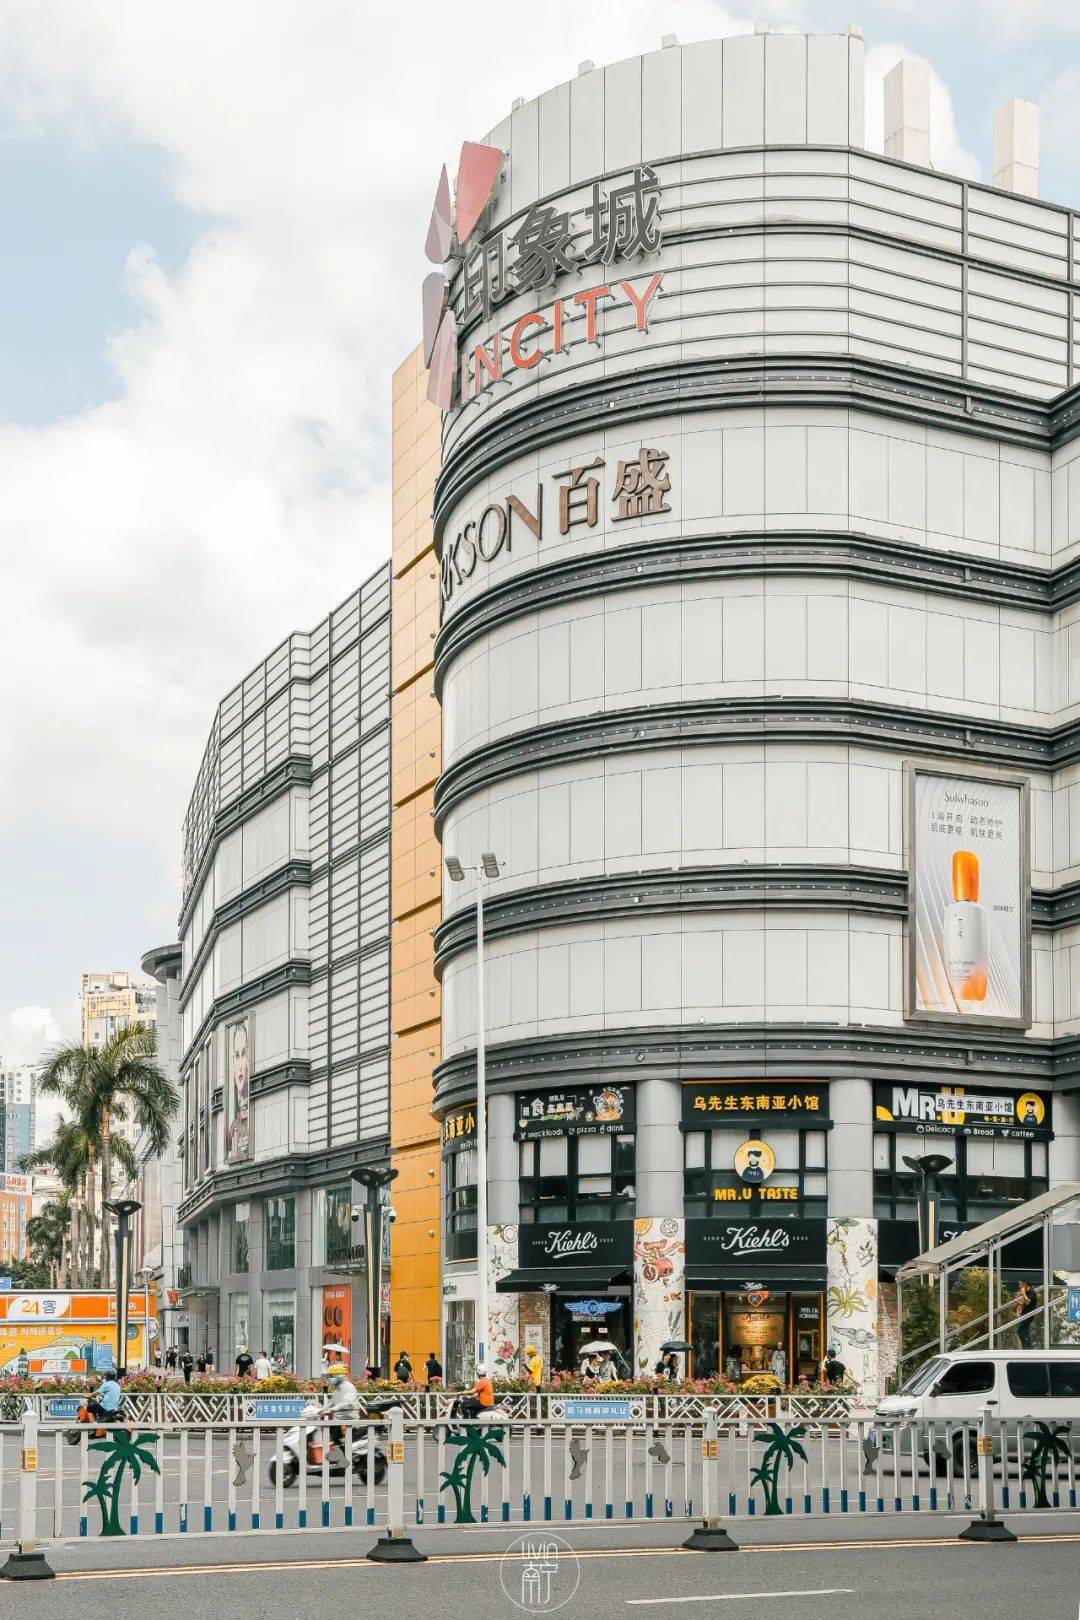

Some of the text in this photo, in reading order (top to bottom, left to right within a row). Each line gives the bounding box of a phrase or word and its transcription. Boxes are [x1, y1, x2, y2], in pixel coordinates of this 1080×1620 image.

[457, 166, 663, 321] 印象城
[460, 273, 664, 404] INCITY
[552, 448, 671, 534] 百盛
[944, 791, 989, 808] Sulwhasoo
[693, 1095, 819, 1111] 乌先生东南亚小馆
[936, 1098, 1013, 1114] 乌先生东南亚小馆
[714, 1187, 798, 1201] MR.U TASTE
[544, 1230, 598, 1254] Kiehl's
[721, 1226, 790, 1250] Kiehl's
